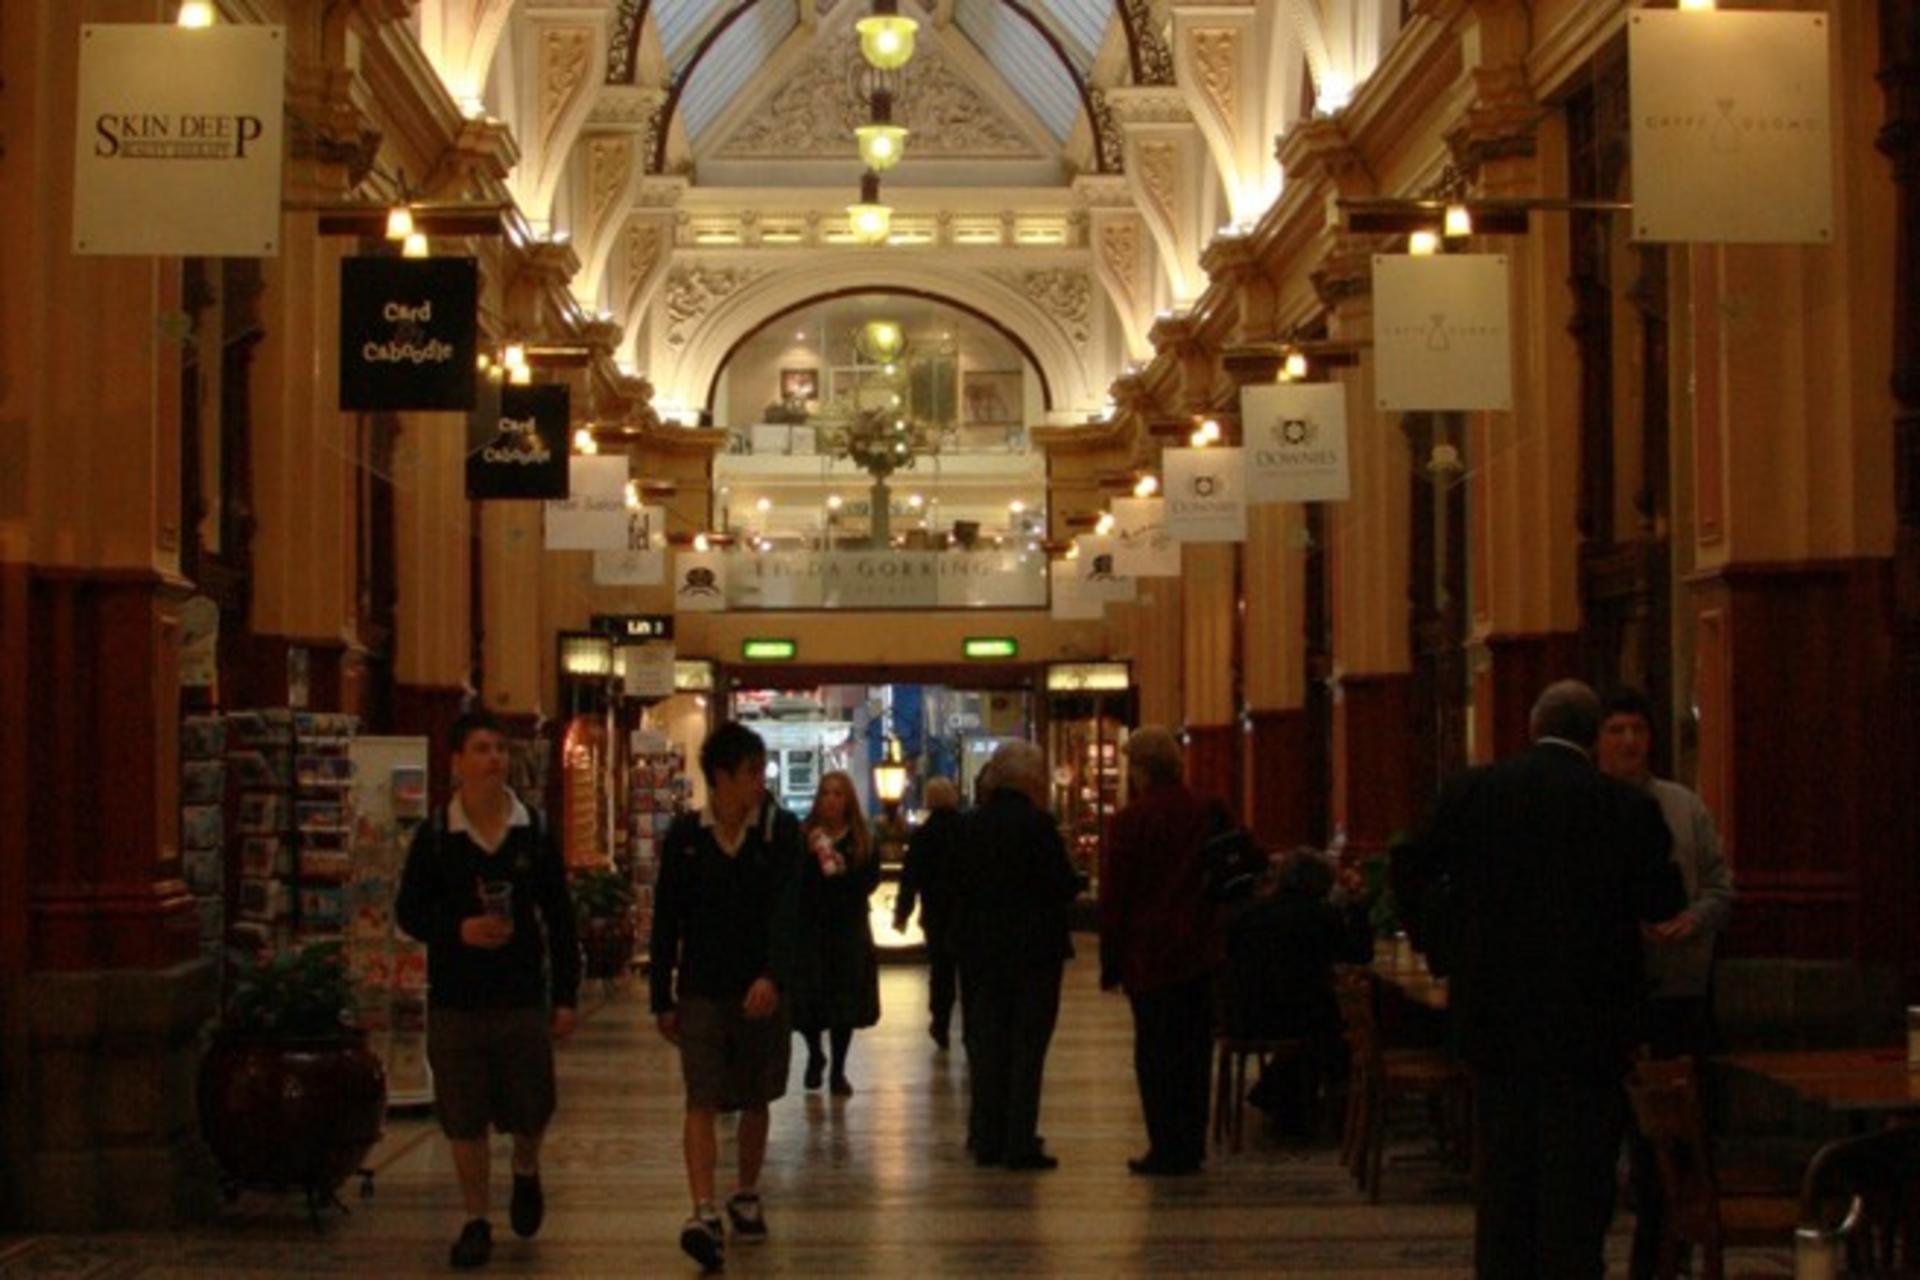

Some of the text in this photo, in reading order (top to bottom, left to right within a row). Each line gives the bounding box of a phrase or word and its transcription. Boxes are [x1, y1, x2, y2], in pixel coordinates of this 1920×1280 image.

[96, 113, 263, 158] SKIN DEEP
[384, 300, 432, 322] Card
[362, 339, 454, 364] Caboodle
[499, 416, 537, 432] Card
